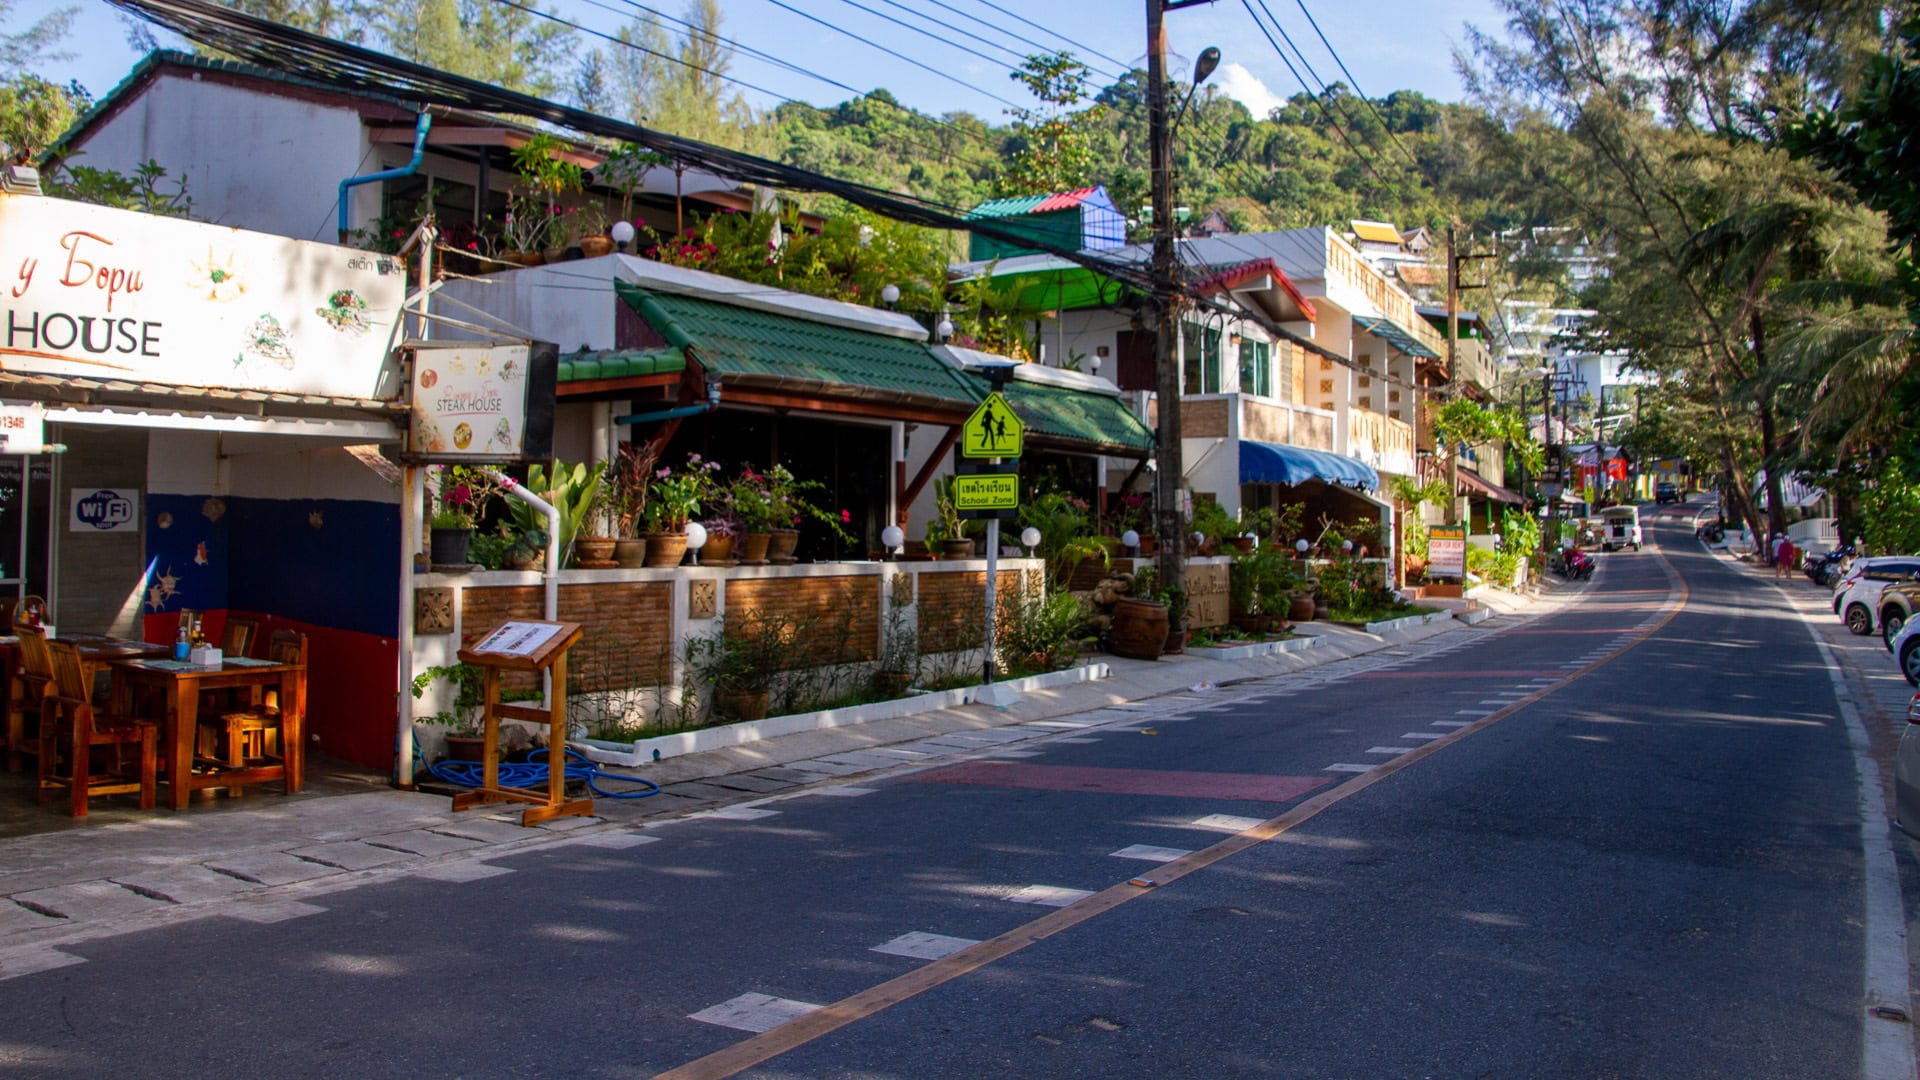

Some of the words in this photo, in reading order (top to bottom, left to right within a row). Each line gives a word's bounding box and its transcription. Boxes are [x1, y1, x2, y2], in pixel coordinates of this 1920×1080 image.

[12, 257, 38, 298] у
[59, 231, 144, 313] Бори
[7, 309, 162, 357] HOUSE
[436, 399, 466, 412] STEAK
[468, 398, 502, 412] HOUSE
[0, 416, 25, 429] 1348
[961, 496, 988, 504] School
